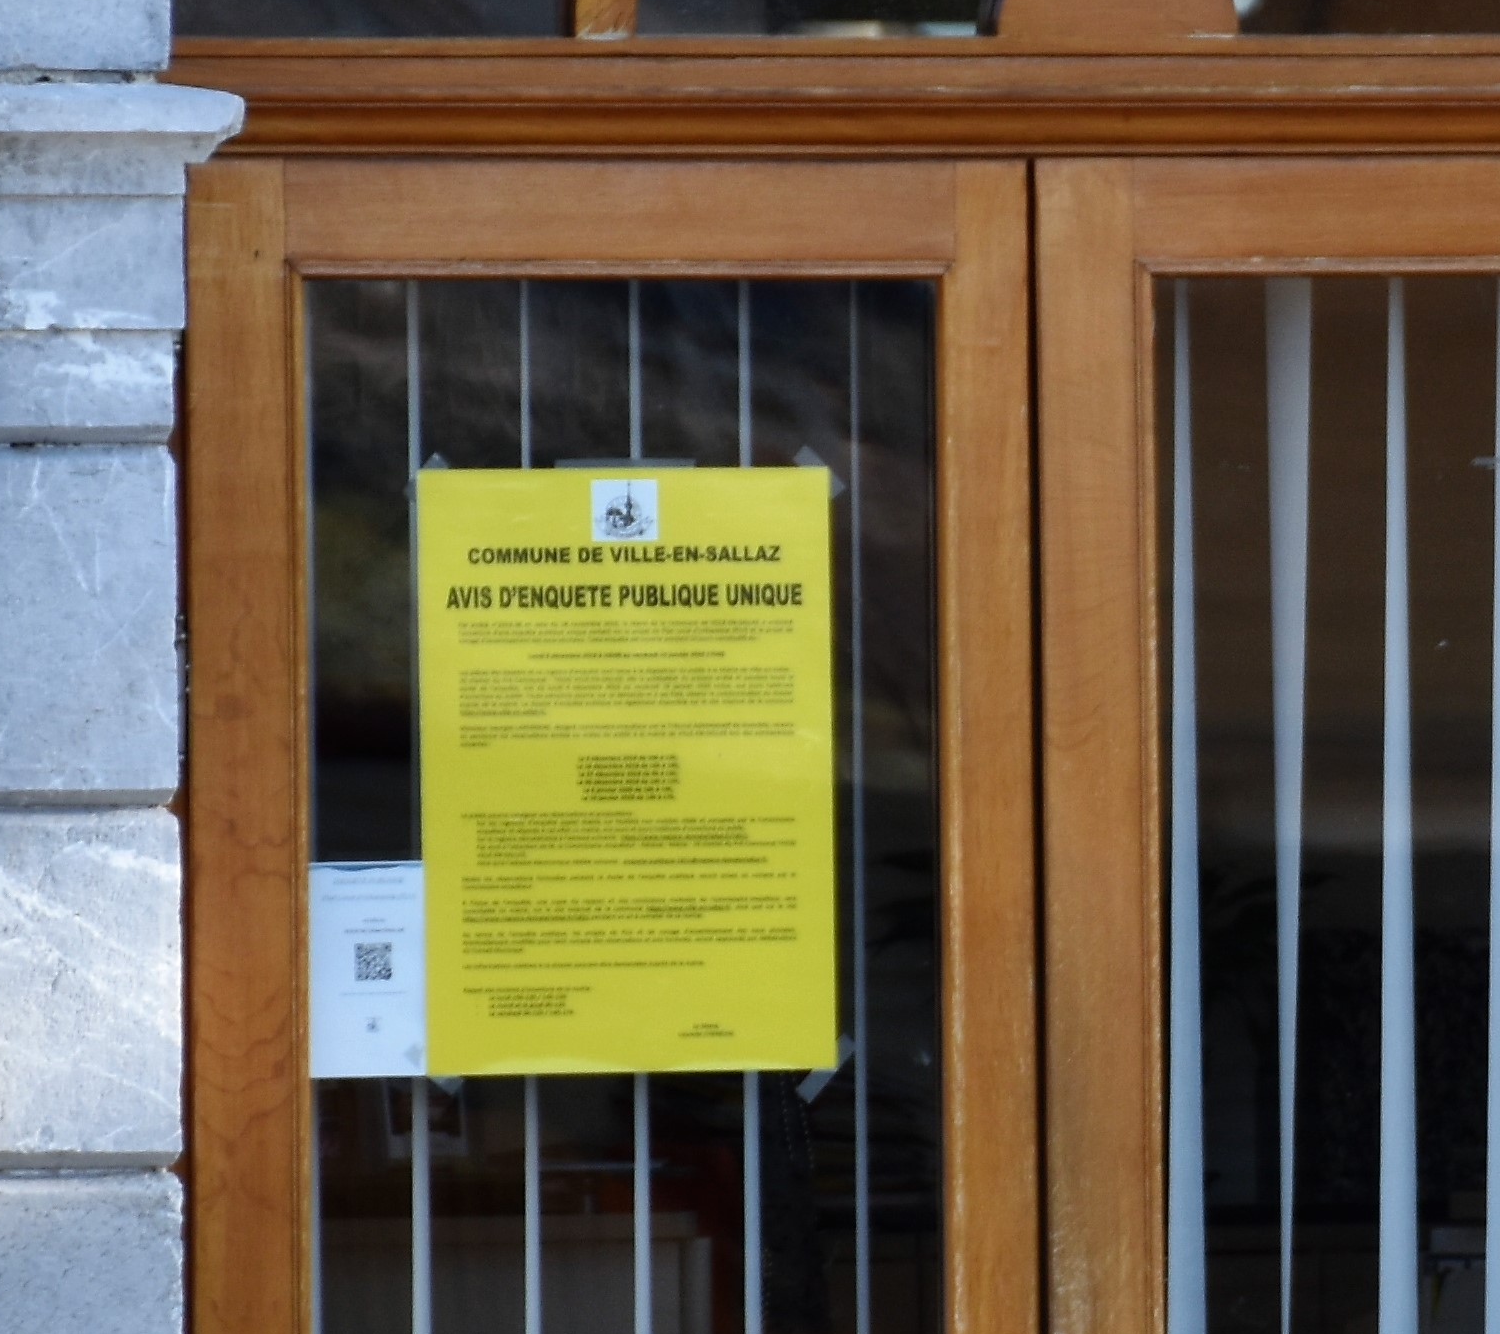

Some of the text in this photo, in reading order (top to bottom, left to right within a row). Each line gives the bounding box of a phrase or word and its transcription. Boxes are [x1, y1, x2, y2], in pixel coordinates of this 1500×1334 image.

[467, 544, 781, 565] COMMUNE DE VILLE-EN-SALLAZ
[446, 582, 803, 610] AVIS D'ENQUETE PUBLIQUE UNIQUE
